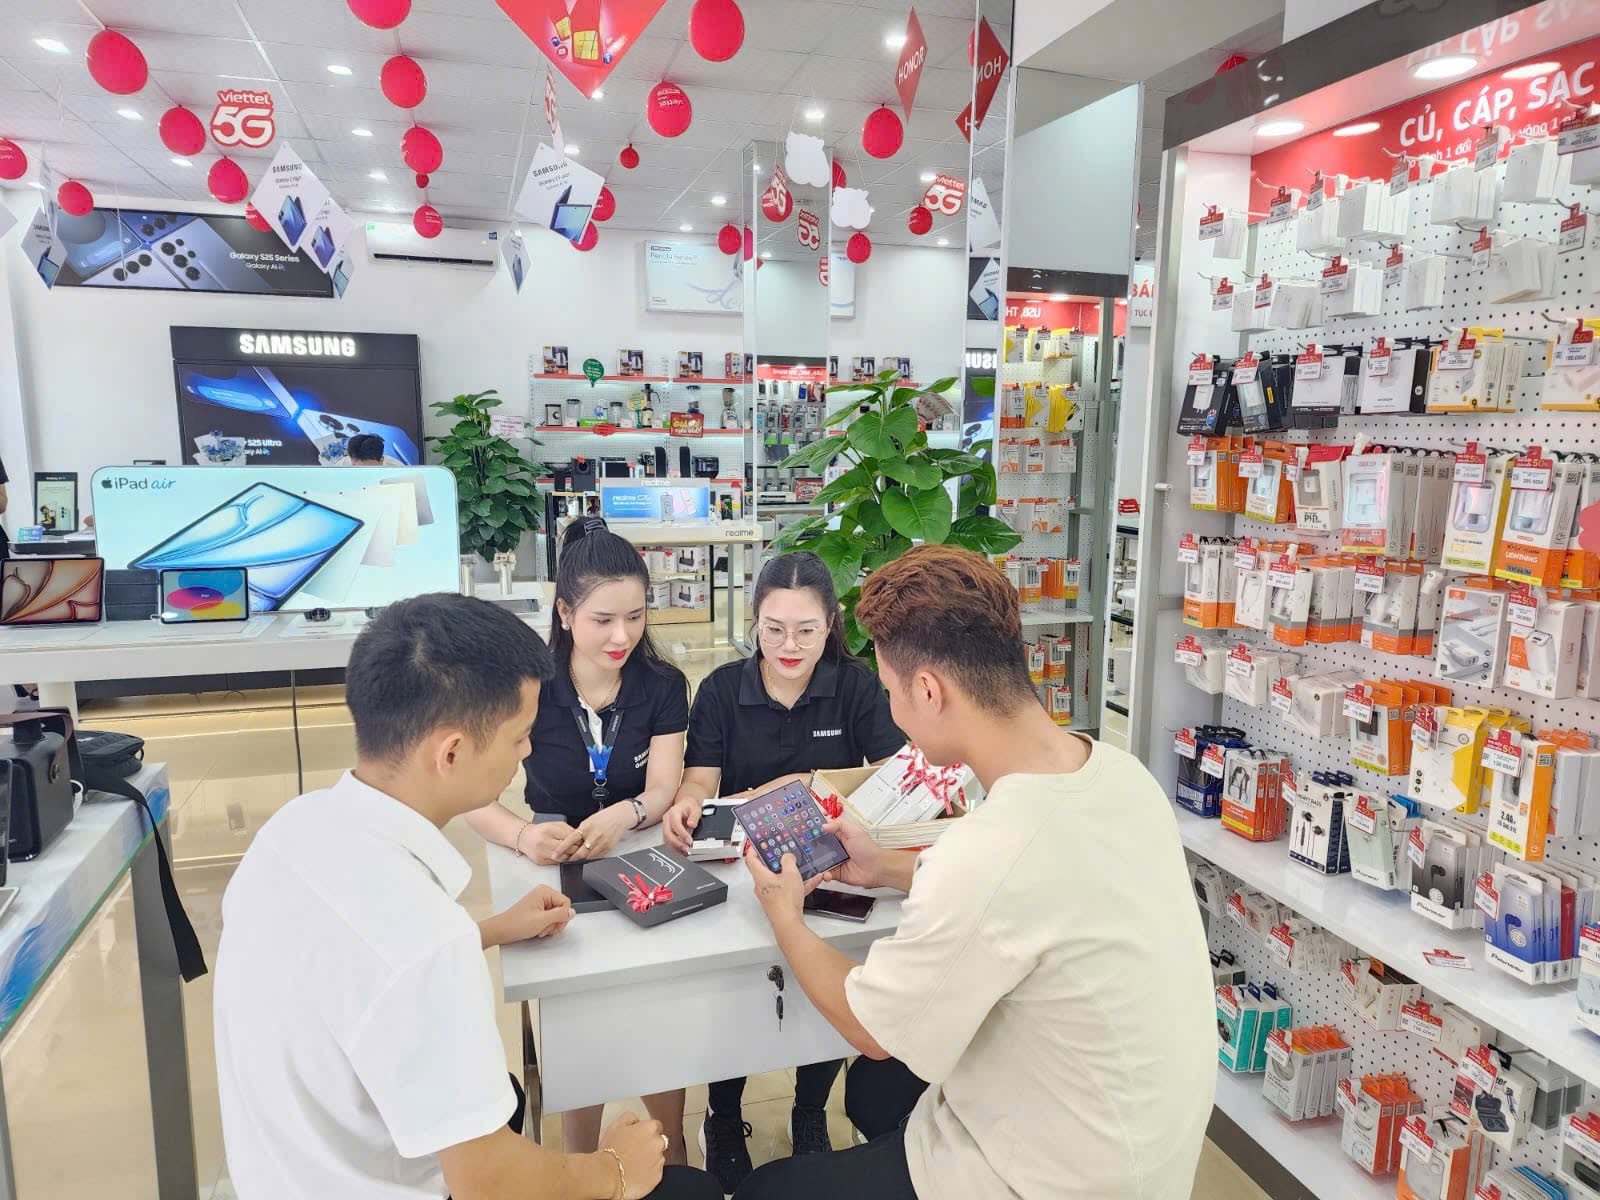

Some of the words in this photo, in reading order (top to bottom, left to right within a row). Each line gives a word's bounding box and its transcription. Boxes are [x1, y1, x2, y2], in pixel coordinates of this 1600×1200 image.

[898, 46, 924, 85] HONOR
[220, 92, 271, 104] viettel
[1400, 103, 1443, 147] CỦ,
[1453, 84, 1516, 131] CÁP,
[1527, 61, 1595, 110] SẠC
[212, 105, 273, 146] 5G
[925, 184, 963, 215] 5G
[230, 252, 259, 261] Galaxy
[260, 253, 273, 261] S25
[275, 254, 300, 263] Series
[246, 262, 269, 270] Galaxy
[239, 334, 356, 357] SAMSUNG
[247, 439, 261, 447] S25
[262, 439, 282, 447] Ultra
[115, 477, 148, 490] iPad
[151, 478, 176, 490] air
[725, 529, 754, 538] realme
